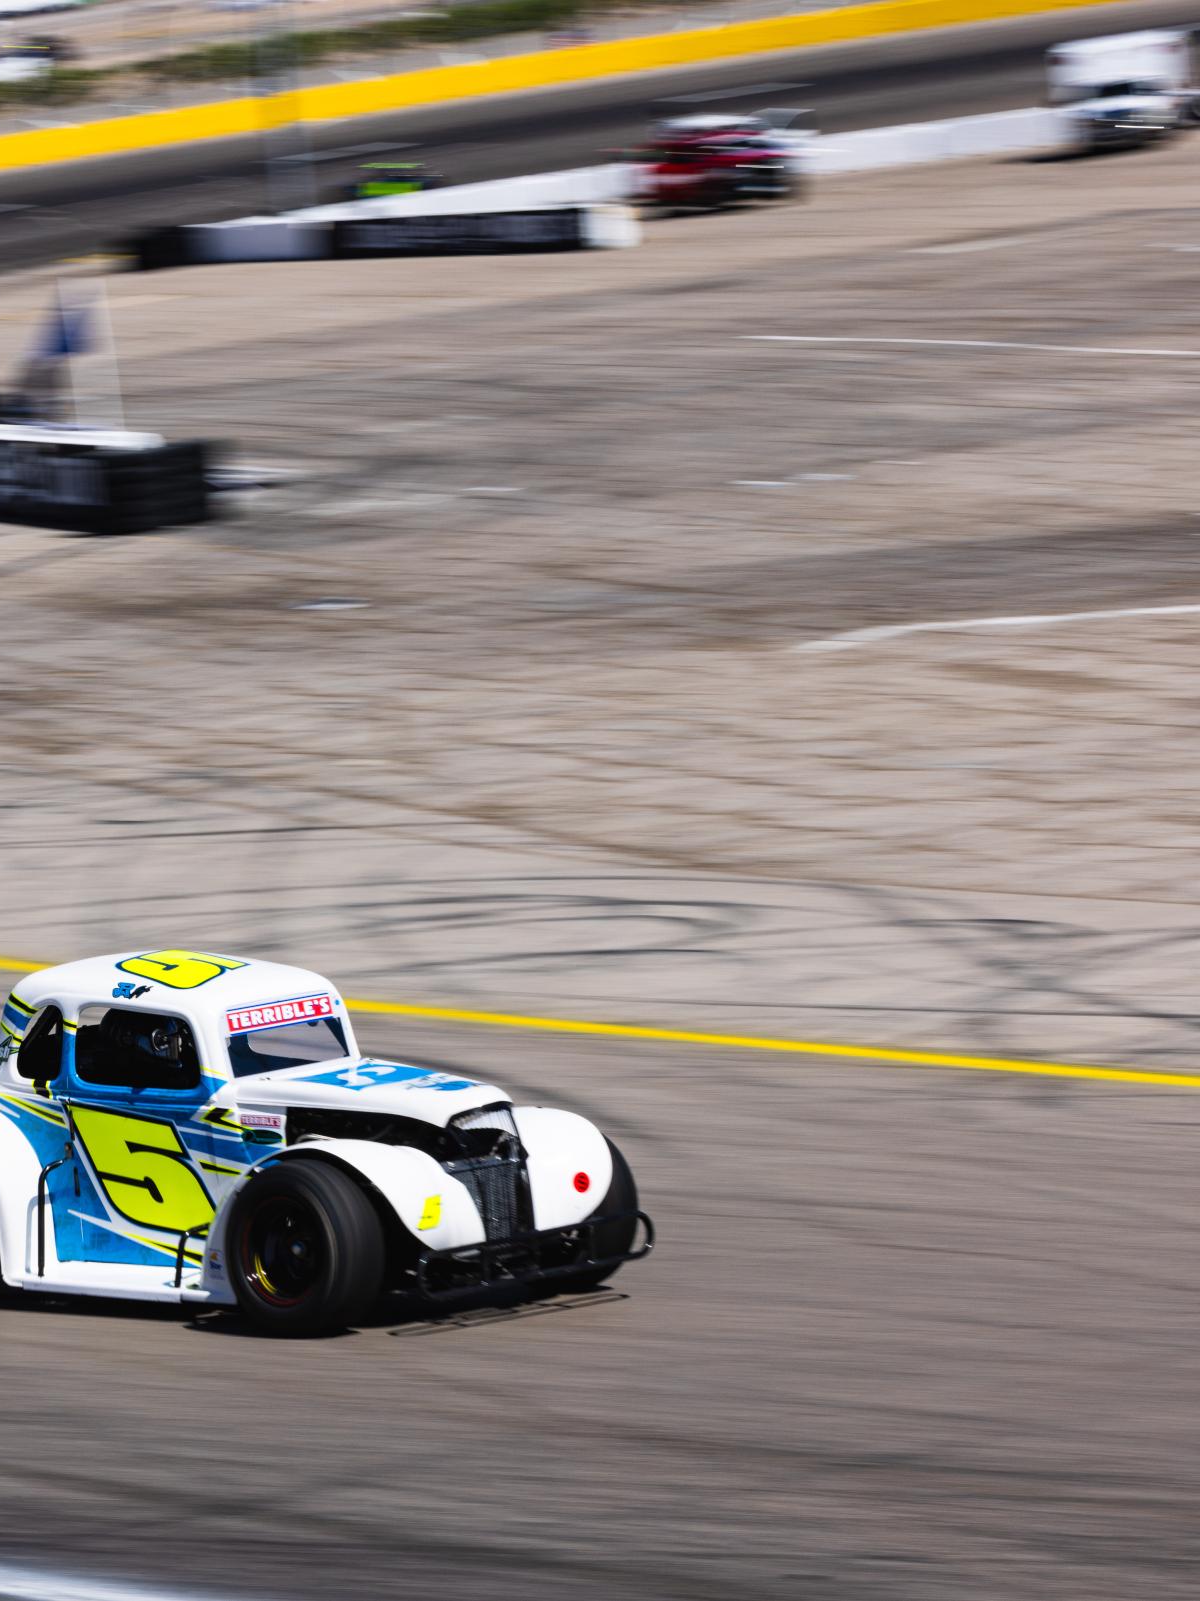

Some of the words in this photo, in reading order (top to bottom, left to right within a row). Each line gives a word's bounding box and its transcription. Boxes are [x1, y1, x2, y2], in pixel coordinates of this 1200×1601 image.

[116, 950, 250, 989] 5
[229, 998, 331, 1030] TERRIBLE'S
[65, 1104, 216, 1238] 5
[416, 1194, 442, 1231] 5
